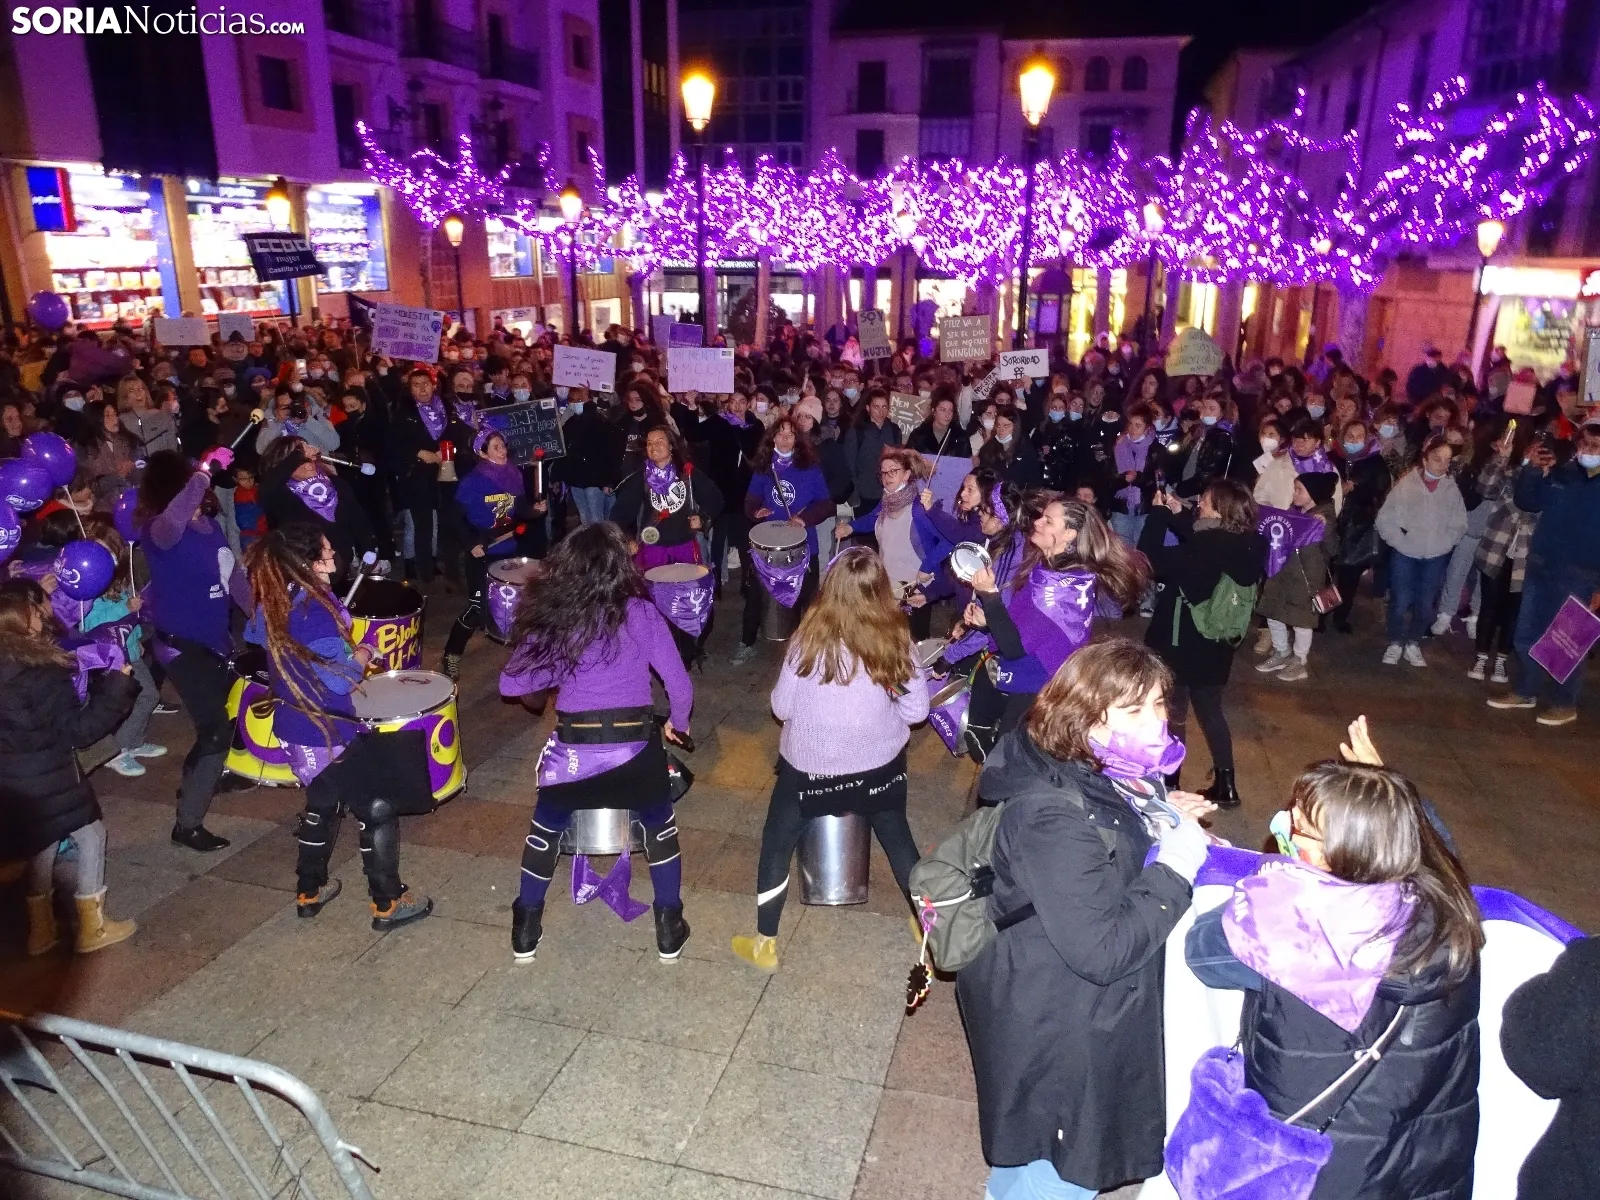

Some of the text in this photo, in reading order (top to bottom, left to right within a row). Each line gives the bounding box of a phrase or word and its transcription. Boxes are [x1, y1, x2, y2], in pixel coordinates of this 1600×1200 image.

[946, 348, 986, 358] NINGUNA
[1001, 355, 1041, 367] SORORIDAD
[798, 780, 864, 801] Tuesday
